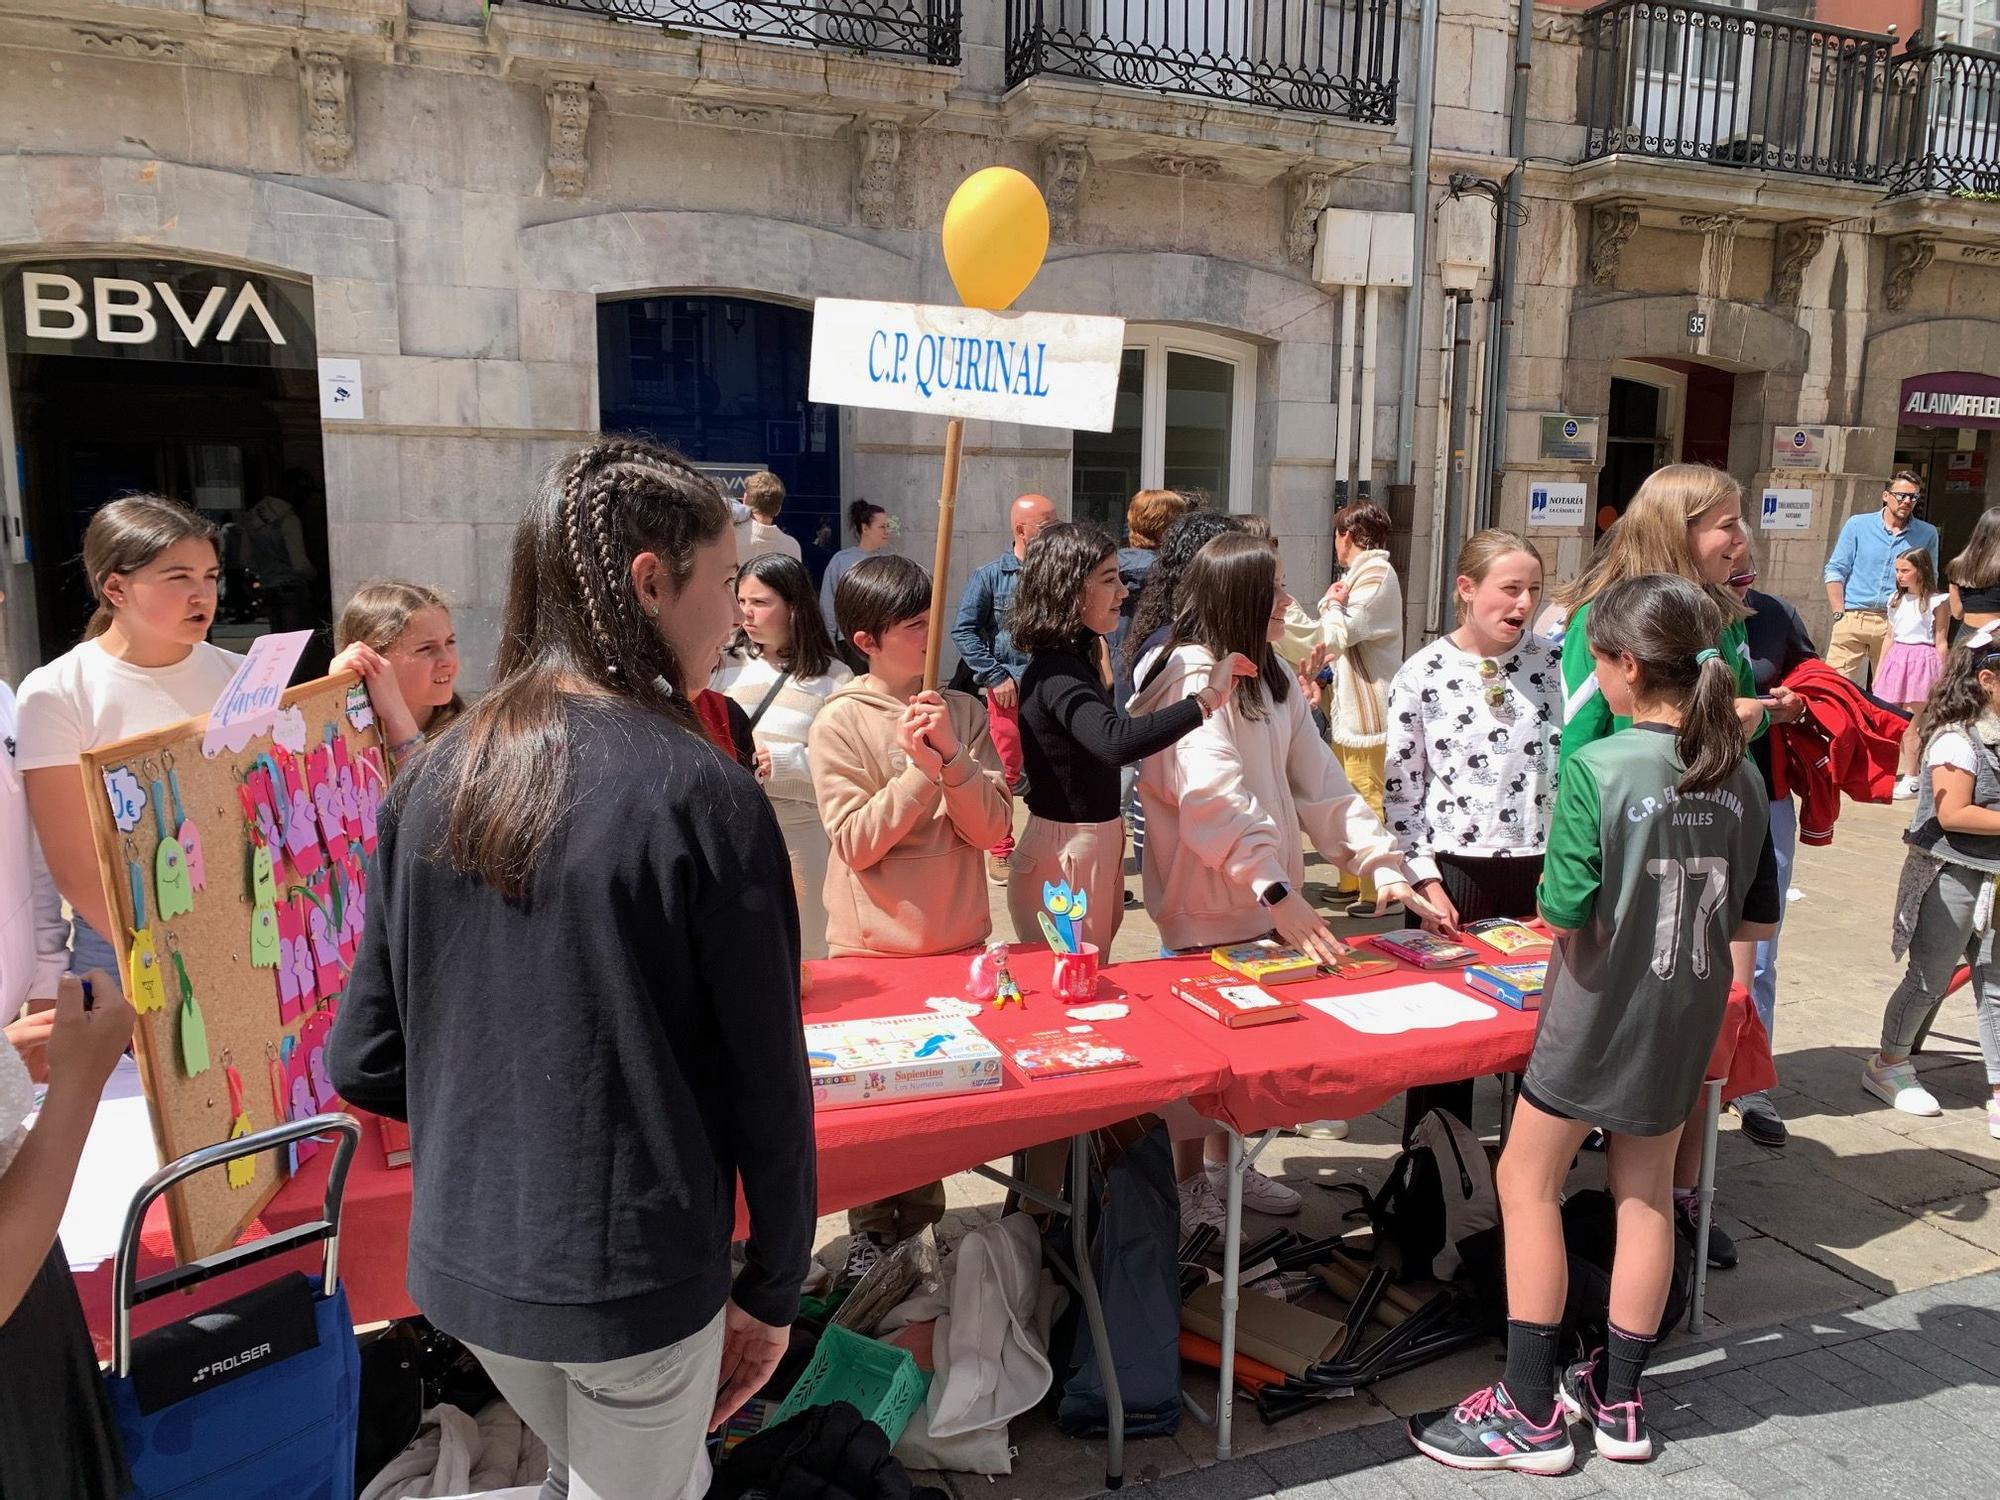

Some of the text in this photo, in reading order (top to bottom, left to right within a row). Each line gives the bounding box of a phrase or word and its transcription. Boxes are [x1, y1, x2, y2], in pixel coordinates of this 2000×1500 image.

[22, 271, 287, 348] BBVA
[1690, 316, 1704, 333] 35
[868, 330, 1050, 399] C.P. QUIRINAL
[1549, 495, 1584, 505] NOTARÍA
[111, 778, 135, 820] 5€
[1627, 796, 1663, 823] C.P.
[1671, 812, 1714, 827] AVILES
[1646, 856, 1730, 981] 77
[894, 1067, 945, 1083] Sapientino
[211, 1342, 273, 1377] ROLSER
[1505, 1431, 1531, 1452] Reebok
